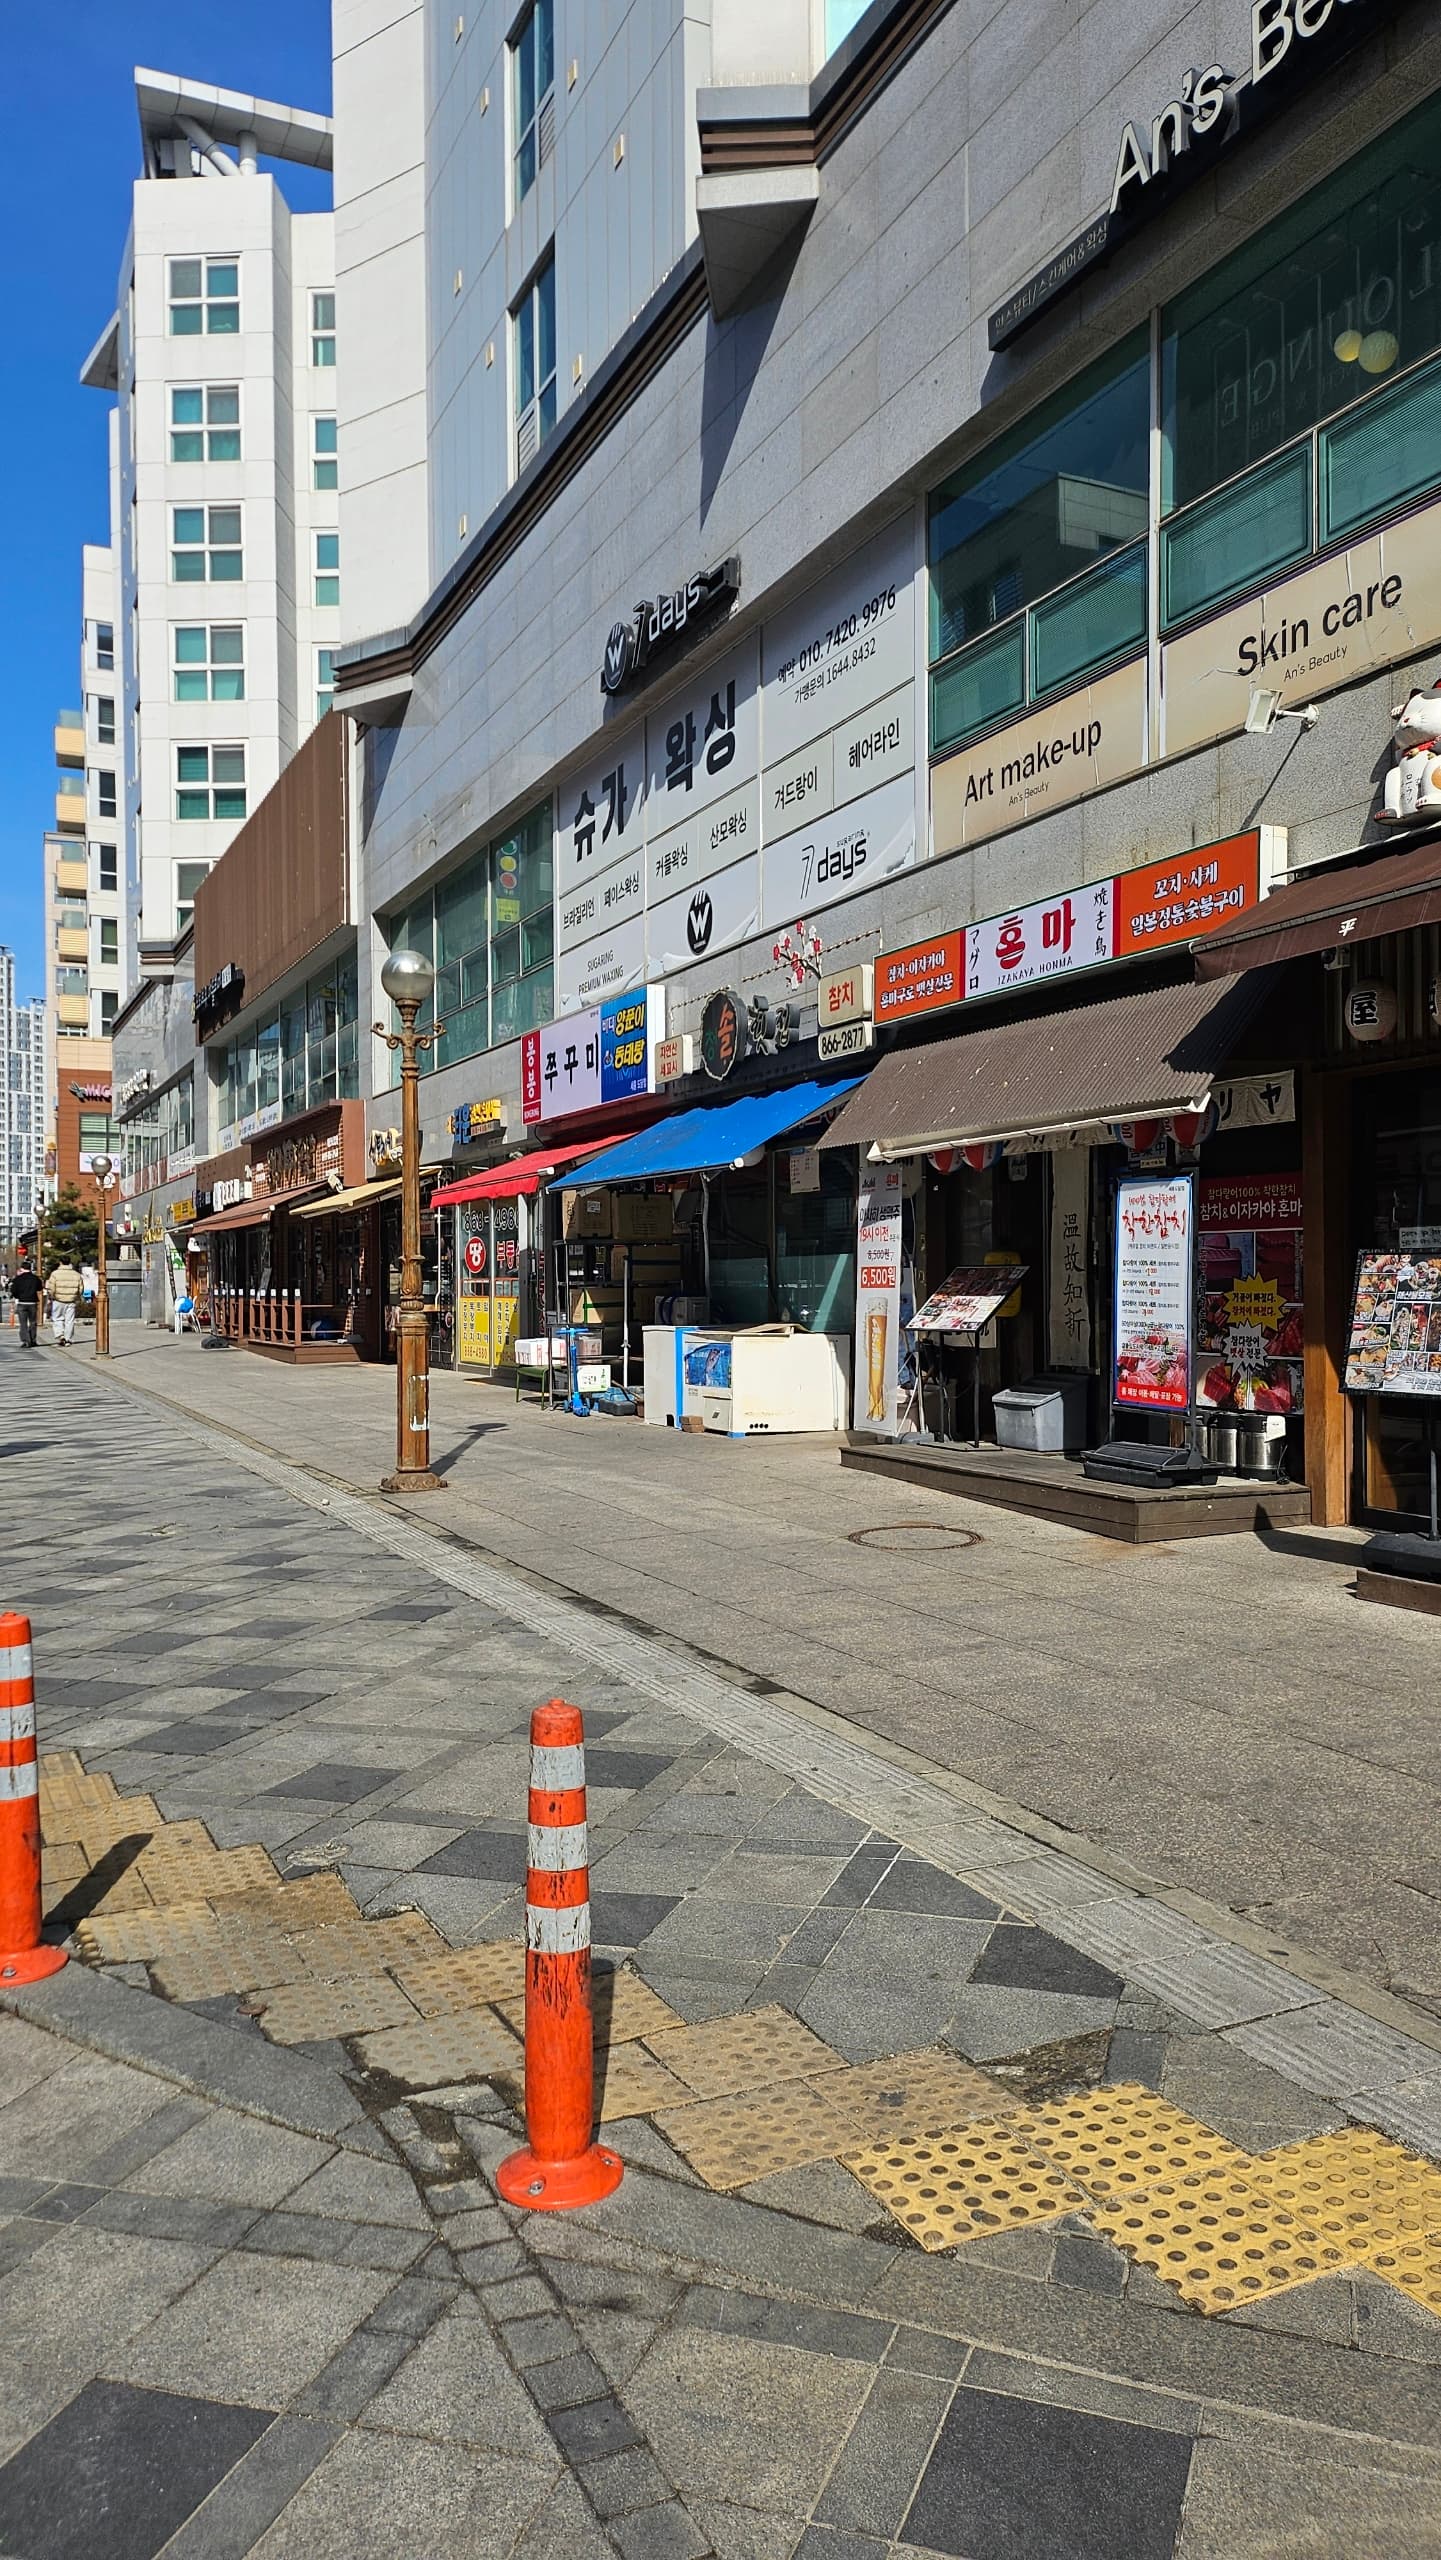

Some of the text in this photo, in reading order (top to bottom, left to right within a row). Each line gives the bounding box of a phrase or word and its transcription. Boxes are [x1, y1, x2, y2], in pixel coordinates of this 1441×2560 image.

[1110, 64, 1224, 214] An's
[1237, 574, 1403, 678] Skin care
[777, 658, 796, 683] 예약
[795, 637, 876, 703] 가맹문의 1644.8432
[1283, 643, 1348, 683] An's Beauty
[849, 718, 900, 768] 헤어라인
[574, 679, 736, 863] 슈가 왁싱
[964, 719, 1102, 807] Art make-up
[774, 766, 818, 810] 겨드랑이
[1008, 780, 1050, 807] An's Beauty
[710, 807, 748, 850] 산모왁싱
[655, 842, 689, 879] 커플왁싱
[604, 870, 640, 908] 페이스왁싱
[563, 896, 596, 930] 브라질리언
[1131, 884, 1245, 937] 일본정통숯불구이
[995, 898, 1077, 970] 혼마
[587, 950, 614, 972] SUGARING
[997, 956, 1073, 985] IZAKAYA HONMA
[578, 965, 624, 996] PREMIUM WAXING
[828, 981, 854, 1012] 참치
[614, 1038, 645, 1069] 동태탕
[660, 1041, 678, 1059] 자연산
[822, 1027, 864, 1055] 866-2877
[1278, 1198, 1303, 1217] 혼마
[875, 1226, 889, 1242] 이전
[861, 1267, 896, 1287] 6,500원
